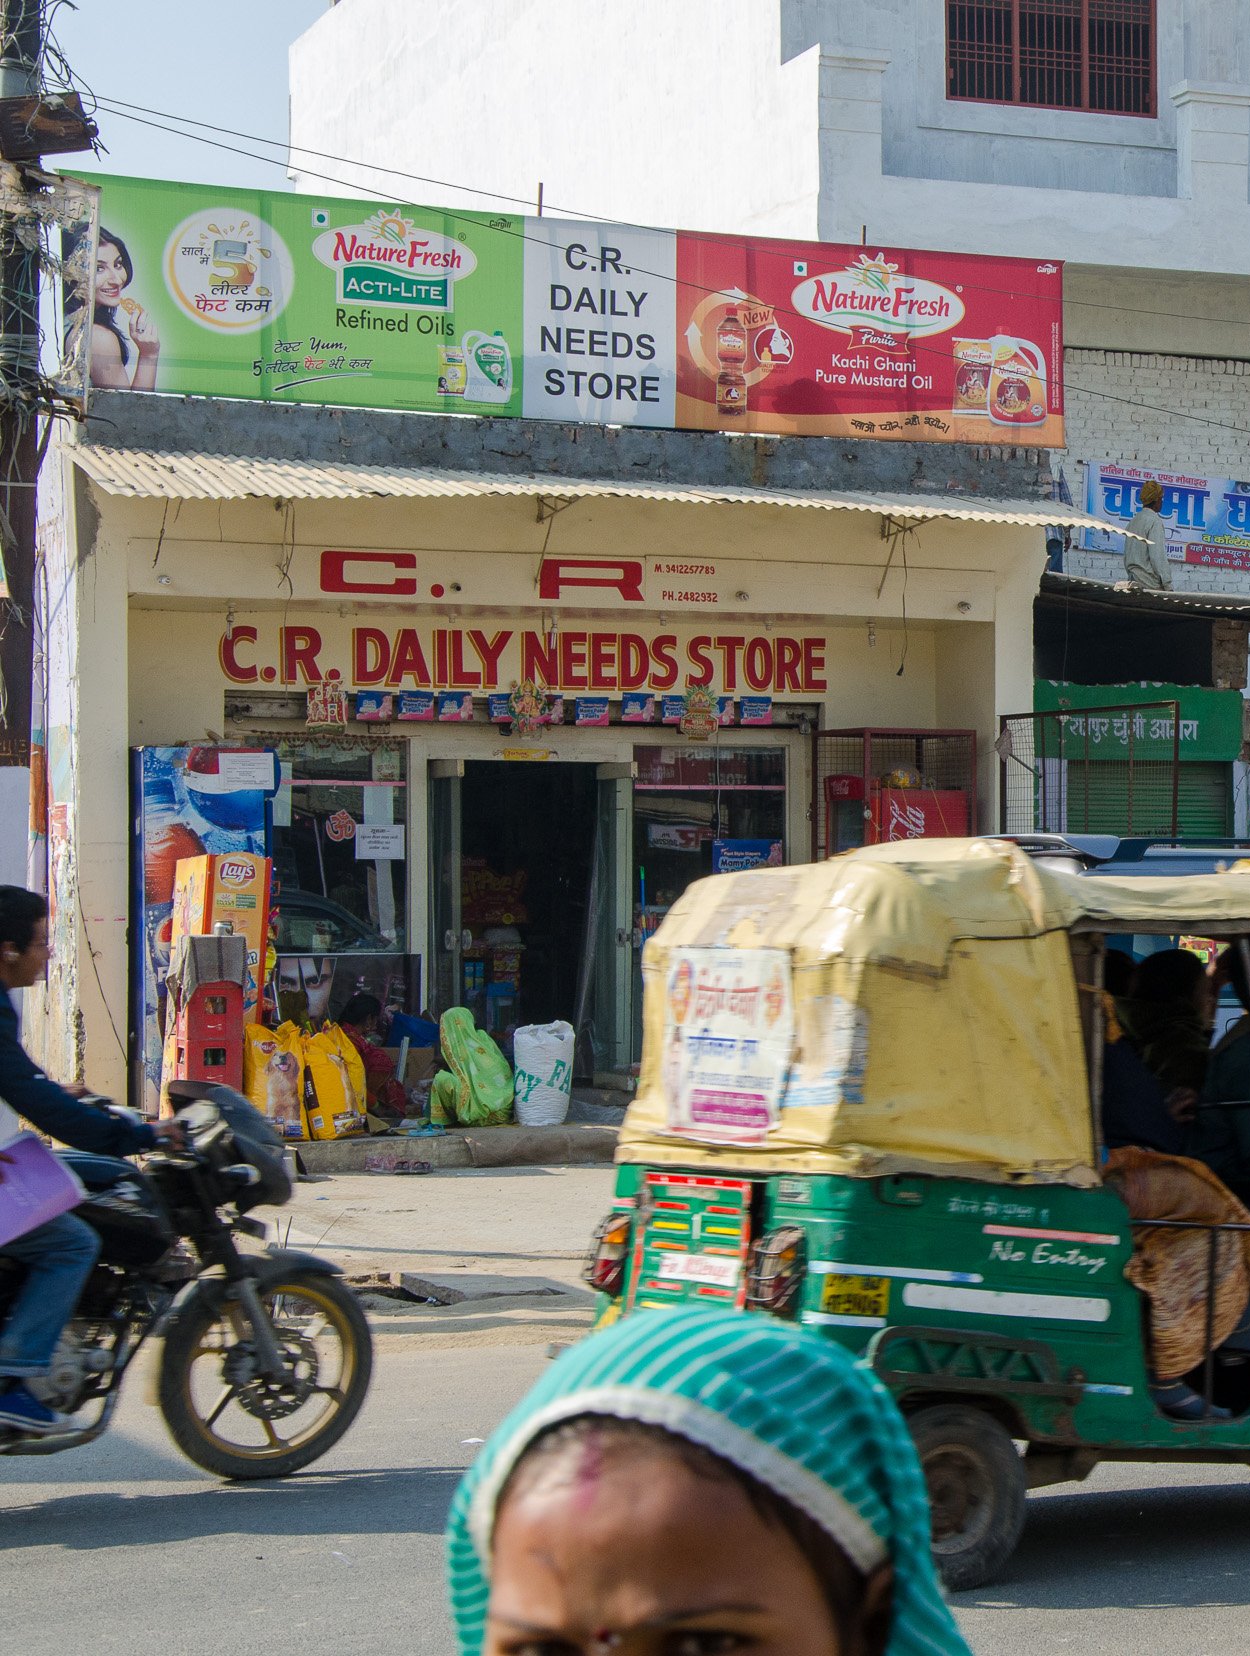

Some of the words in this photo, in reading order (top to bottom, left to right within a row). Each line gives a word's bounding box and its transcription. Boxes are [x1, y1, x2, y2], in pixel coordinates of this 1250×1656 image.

[489, 218, 512, 229] Cargill
[565, 243, 631, 275] C.R.
[211, 281, 251, 296] लीटर
[346, 277, 443, 300] ACTI-LITE
[235, 300, 272, 312] कम
[550, 284, 648, 317] DAILY
[336, 308, 409, 333] Refined
[416, 315, 455, 336] Oils
[743, 310, 770, 325] New
[309, 337, 348, 354] Yum,
[540, 325, 656, 360] NEEDS
[348, 359, 373, 370] कम
[831, 354, 869, 369] Kachi
[873, 356, 916, 372] Ghani
[544, 368, 660, 402] STORE
[815, 369, 847, 384] Pure
[851, 372, 910, 389] Mustard
[911, 376, 932, 389] Oil
[1165, 544, 1183, 553] jput
[219, 625, 342, 686] C.R.
[351, 628, 514, 689] DAILY
[520, 631, 679, 691] NEEDS
[686, 636, 828, 693] STORE
[988, 1240, 1026, 1262] No
[1031, 1242, 1108, 1275] Entry
